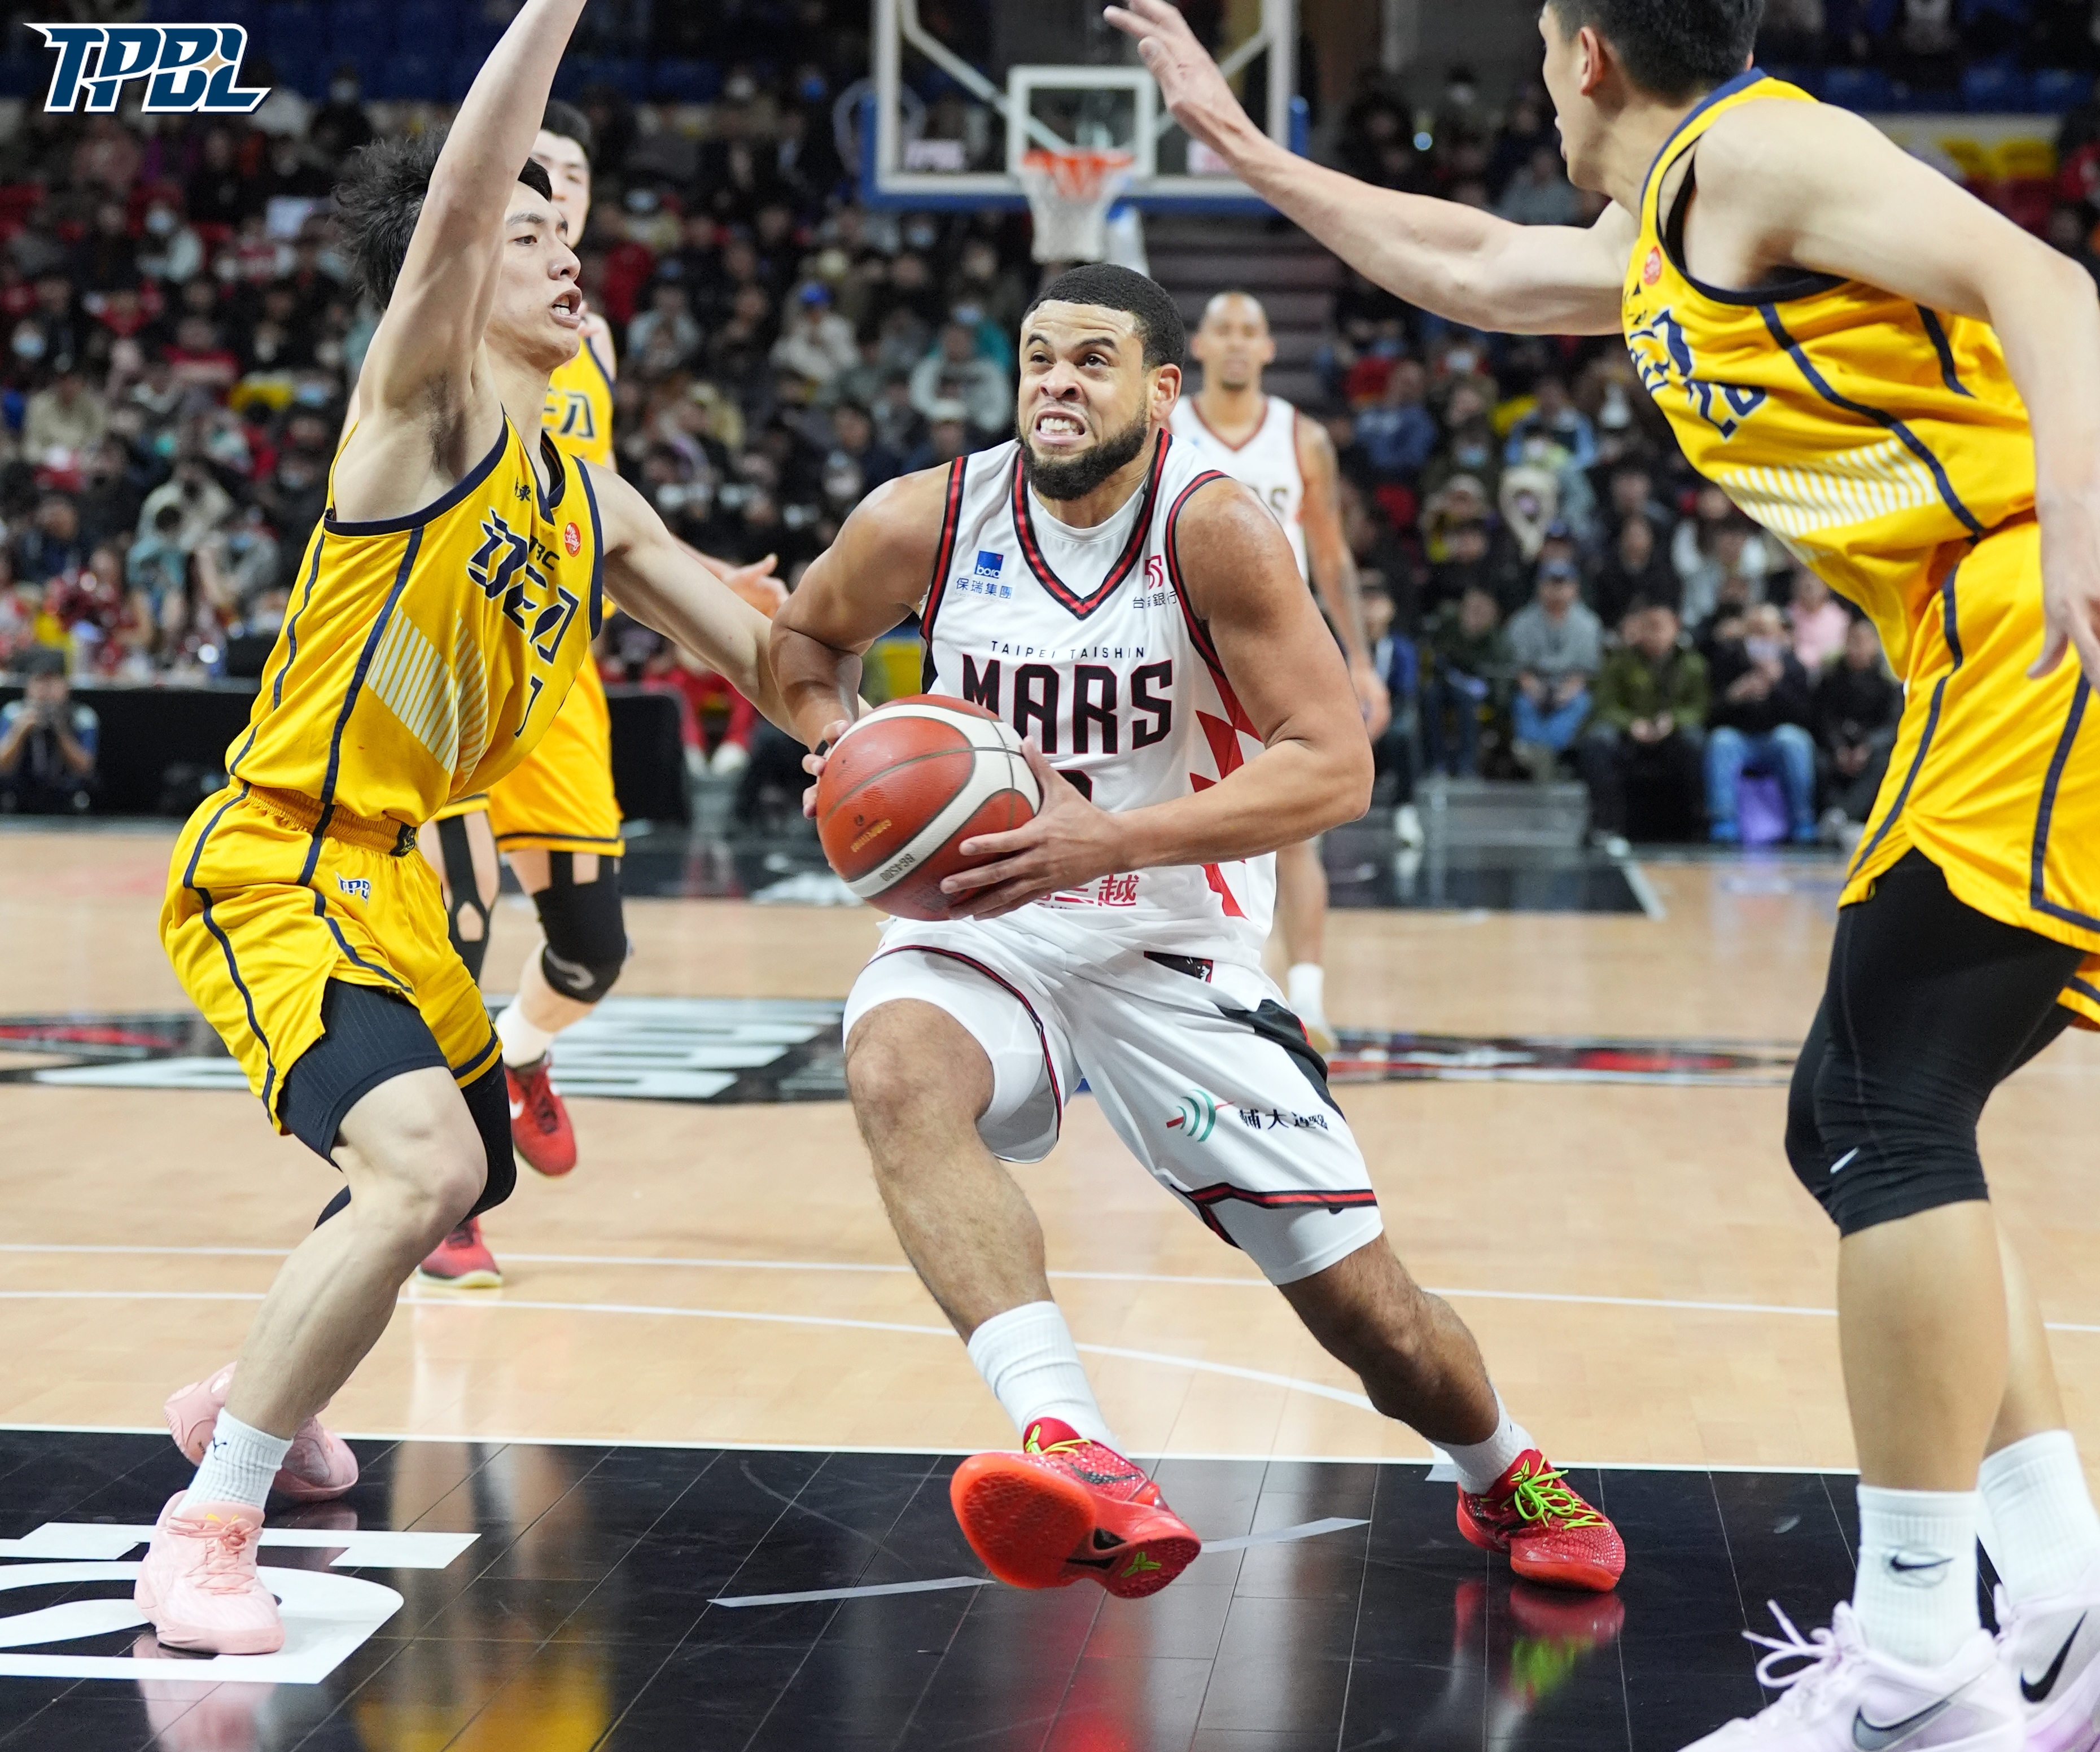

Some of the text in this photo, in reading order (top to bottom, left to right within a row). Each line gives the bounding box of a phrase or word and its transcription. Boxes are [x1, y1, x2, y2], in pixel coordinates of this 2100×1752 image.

[956, 577, 1013, 599] 保瑞集團
[991, 641, 1144, 659] TAIPEI TAISHIN
[962, 654, 1172, 755] MARS
